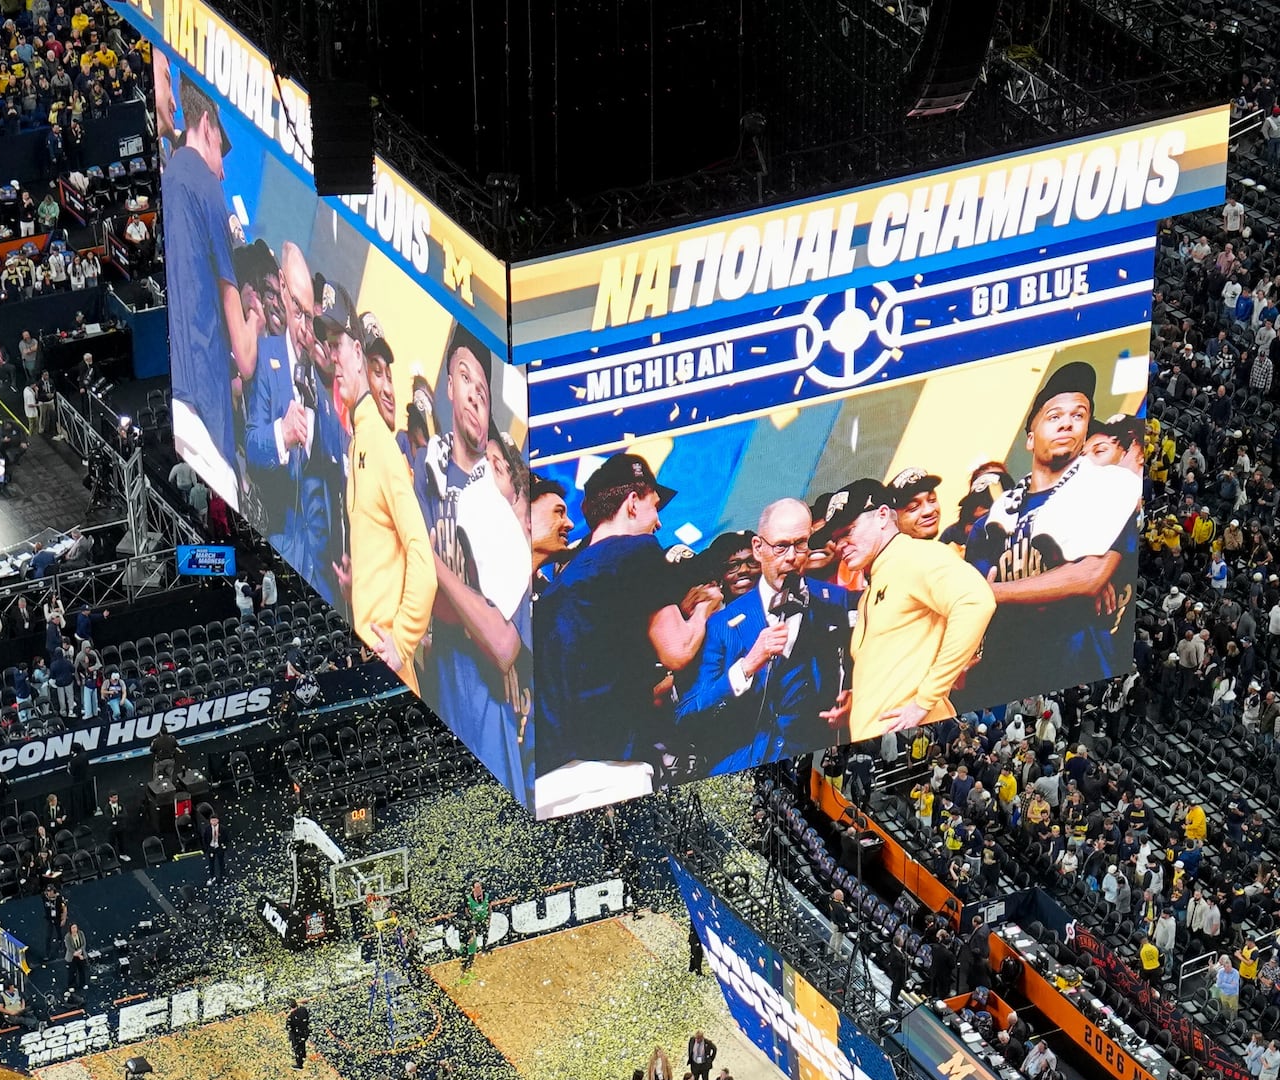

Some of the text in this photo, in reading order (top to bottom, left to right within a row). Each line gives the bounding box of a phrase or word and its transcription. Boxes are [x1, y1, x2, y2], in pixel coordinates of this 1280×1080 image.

[163, 0, 275, 139] NATIONAL
[591, 130, 1187, 332] NATIONAL CHAMPIONS
[972, 263, 1089, 318] GO BLUE
[586, 343, 735, 404] MICHIGAN
[107, 687, 272, 746] HUSKIES
[20, 1014, 108, 1045] 2026
[23, 1025, 110, 1056] NCAA
[1084, 1023, 1125, 1075] 2026
